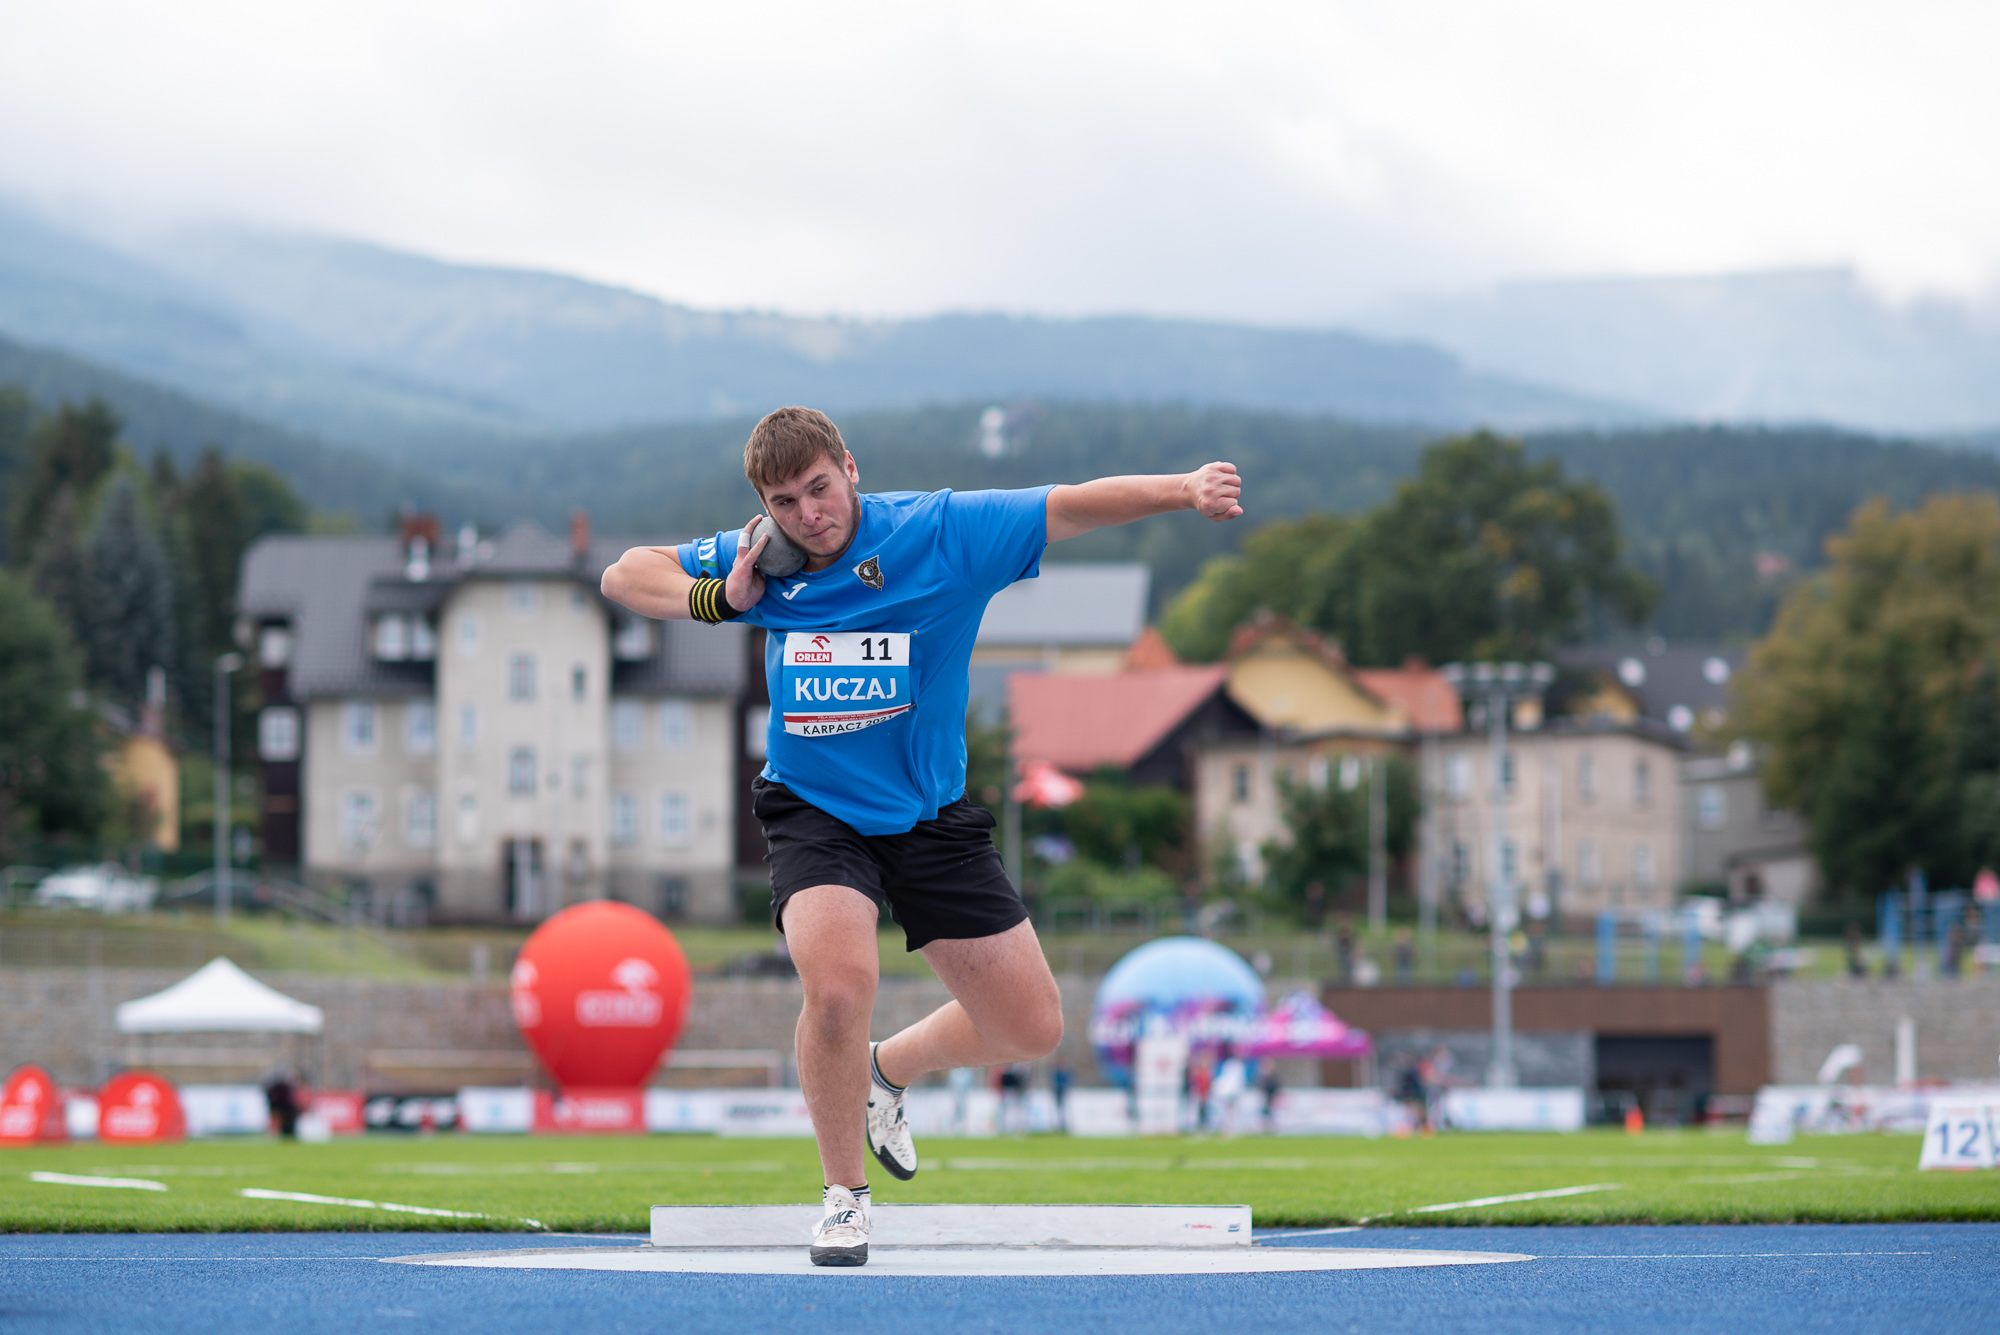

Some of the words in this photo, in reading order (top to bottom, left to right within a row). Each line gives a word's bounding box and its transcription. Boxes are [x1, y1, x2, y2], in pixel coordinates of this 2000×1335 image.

[796, 653, 830, 662] ORLEN
[861, 638, 892, 660] 11
[795, 678, 897, 701] KUCZAJ
[803, 722, 862, 735] KARPACZ
[1933, 1121, 1979, 1157] 12
[822, 1210, 856, 1228] NIKE
